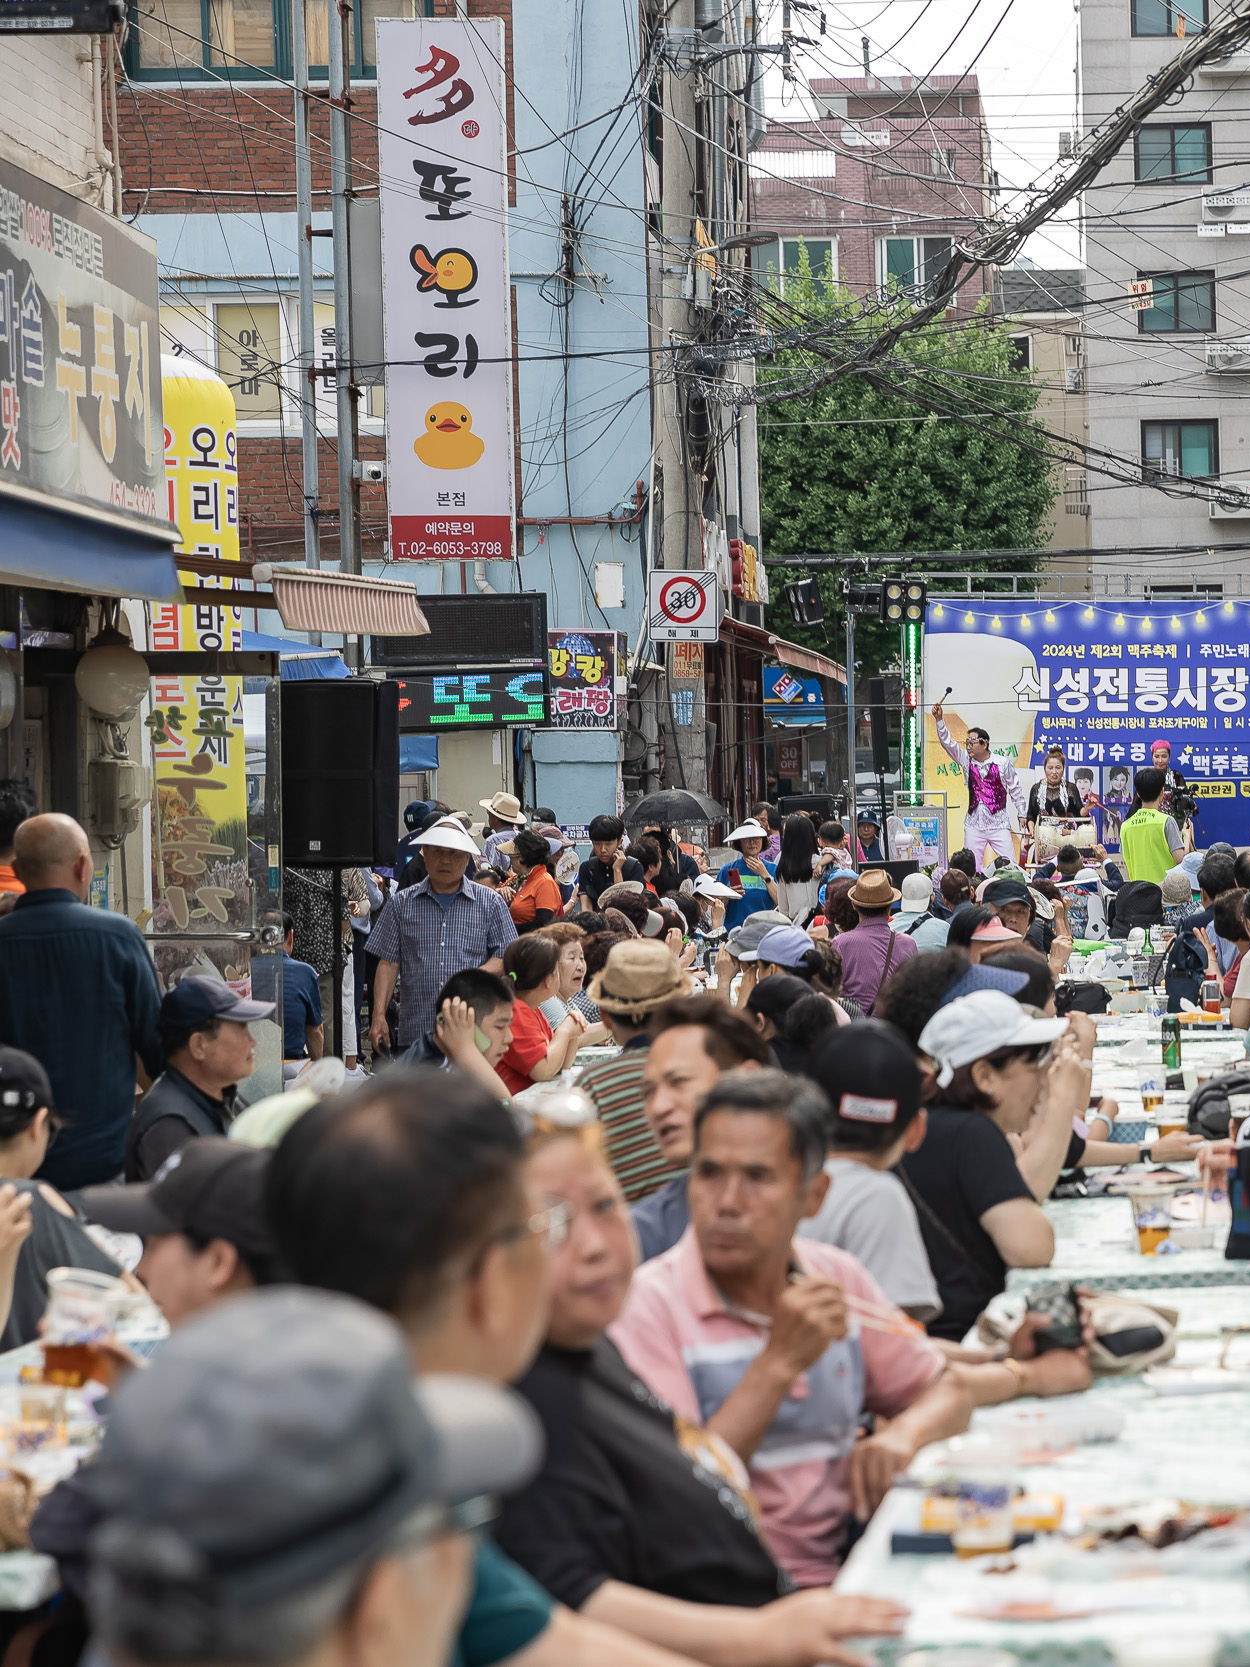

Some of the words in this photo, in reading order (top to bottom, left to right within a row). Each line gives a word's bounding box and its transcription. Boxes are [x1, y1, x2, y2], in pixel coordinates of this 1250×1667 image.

[402, 44, 475, 126] 多
[238, 329, 261, 396] 아로마
[56, 287, 152, 467] 누룽지
[436, 491, 466, 507] 본점
[425, 521, 475, 536] 예약문의
[398, 541, 502, 556] T.02-6053-3798
[670, 590, 696, 610] 30
[1042, 643, 1085, 659] 2024년
[1090, 643, 1122, 659] 제2회
[1127, 643, 1178, 659] 맥주축제
[1013, 666, 1250, 713] 신성전통시장
[1042, 717, 1076, 730] 행사무대
[1086, 716, 1146, 730] 신성전통시장내
[1148, 716, 1208, 729] 포차조개구이앞
[781, 746, 798, 759] 30
[780, 760, 798, 769] OFF
